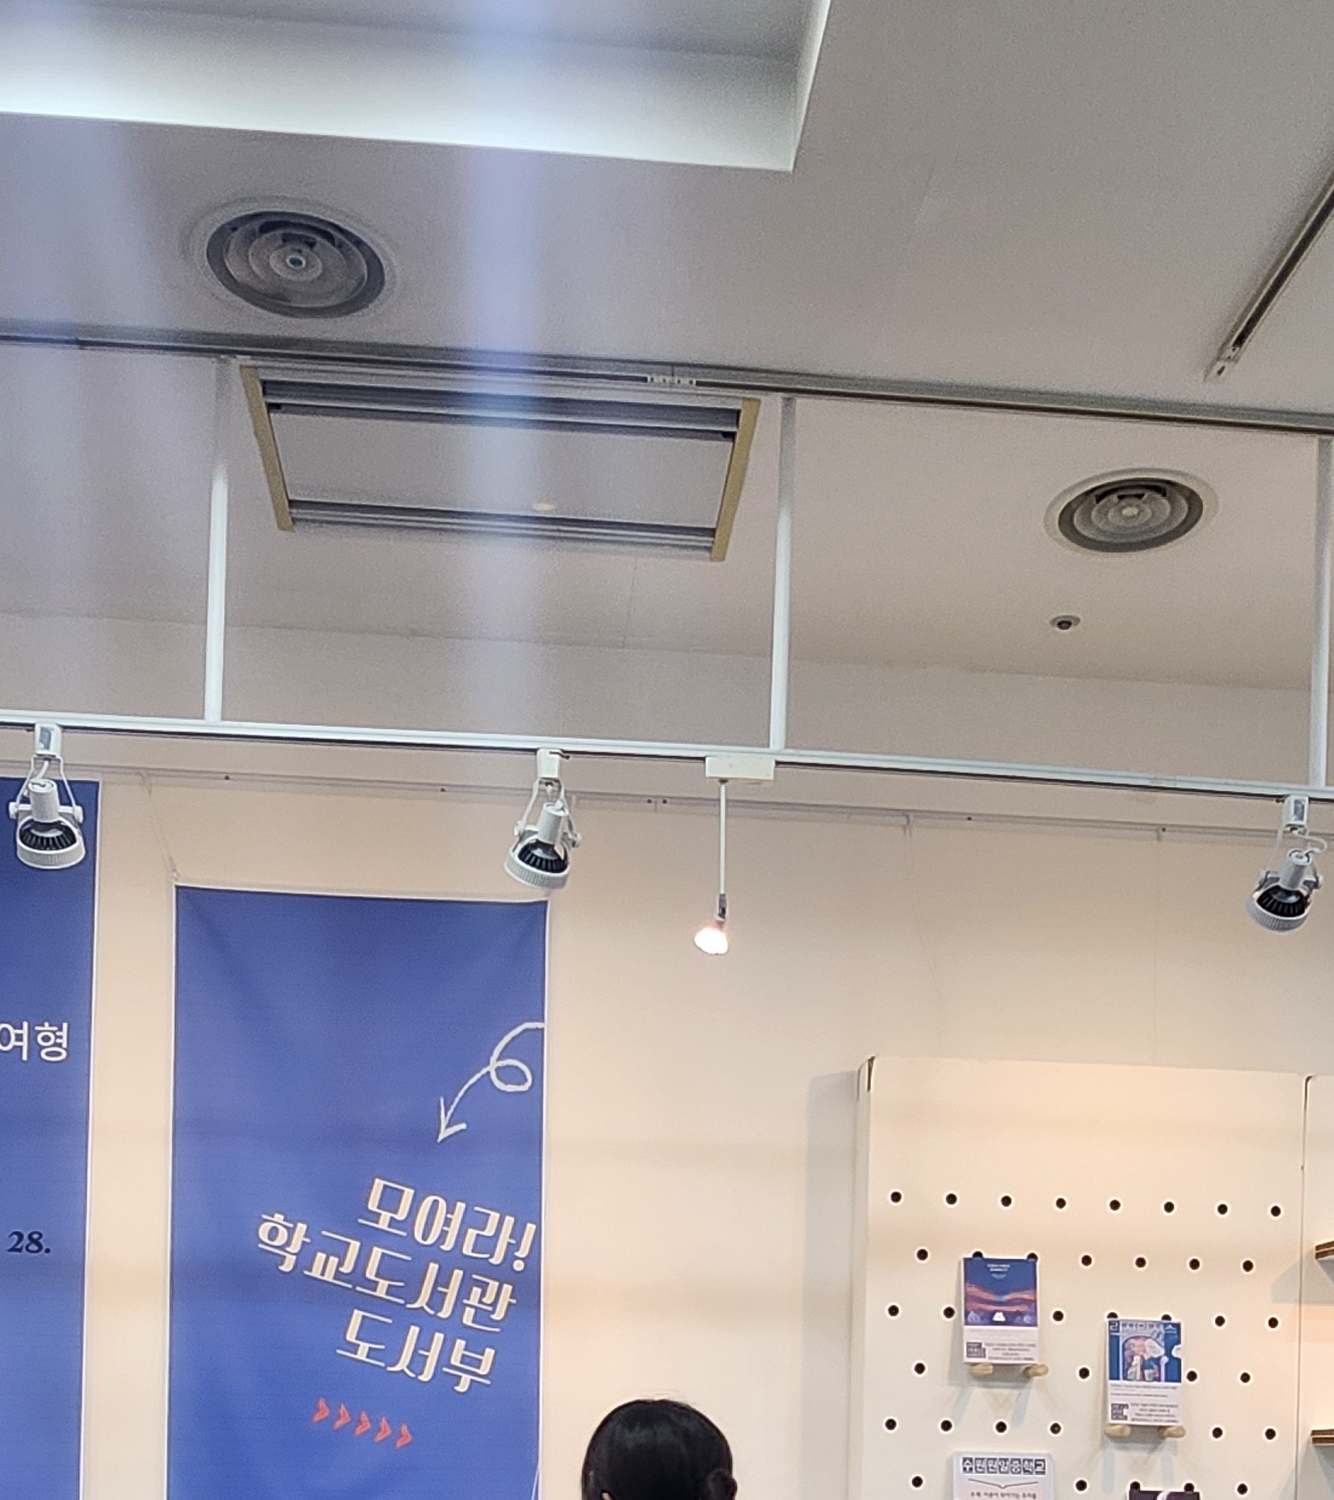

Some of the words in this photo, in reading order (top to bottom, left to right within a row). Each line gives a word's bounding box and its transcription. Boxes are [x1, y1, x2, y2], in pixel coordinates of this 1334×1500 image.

[6, 1229, 52, 1255] 28.
[357, 1175, 538, 1274] 모여라!
[256, 1210, 517, 1334] 학교도서관
[335, 1307, 496, 1394] 도서부
